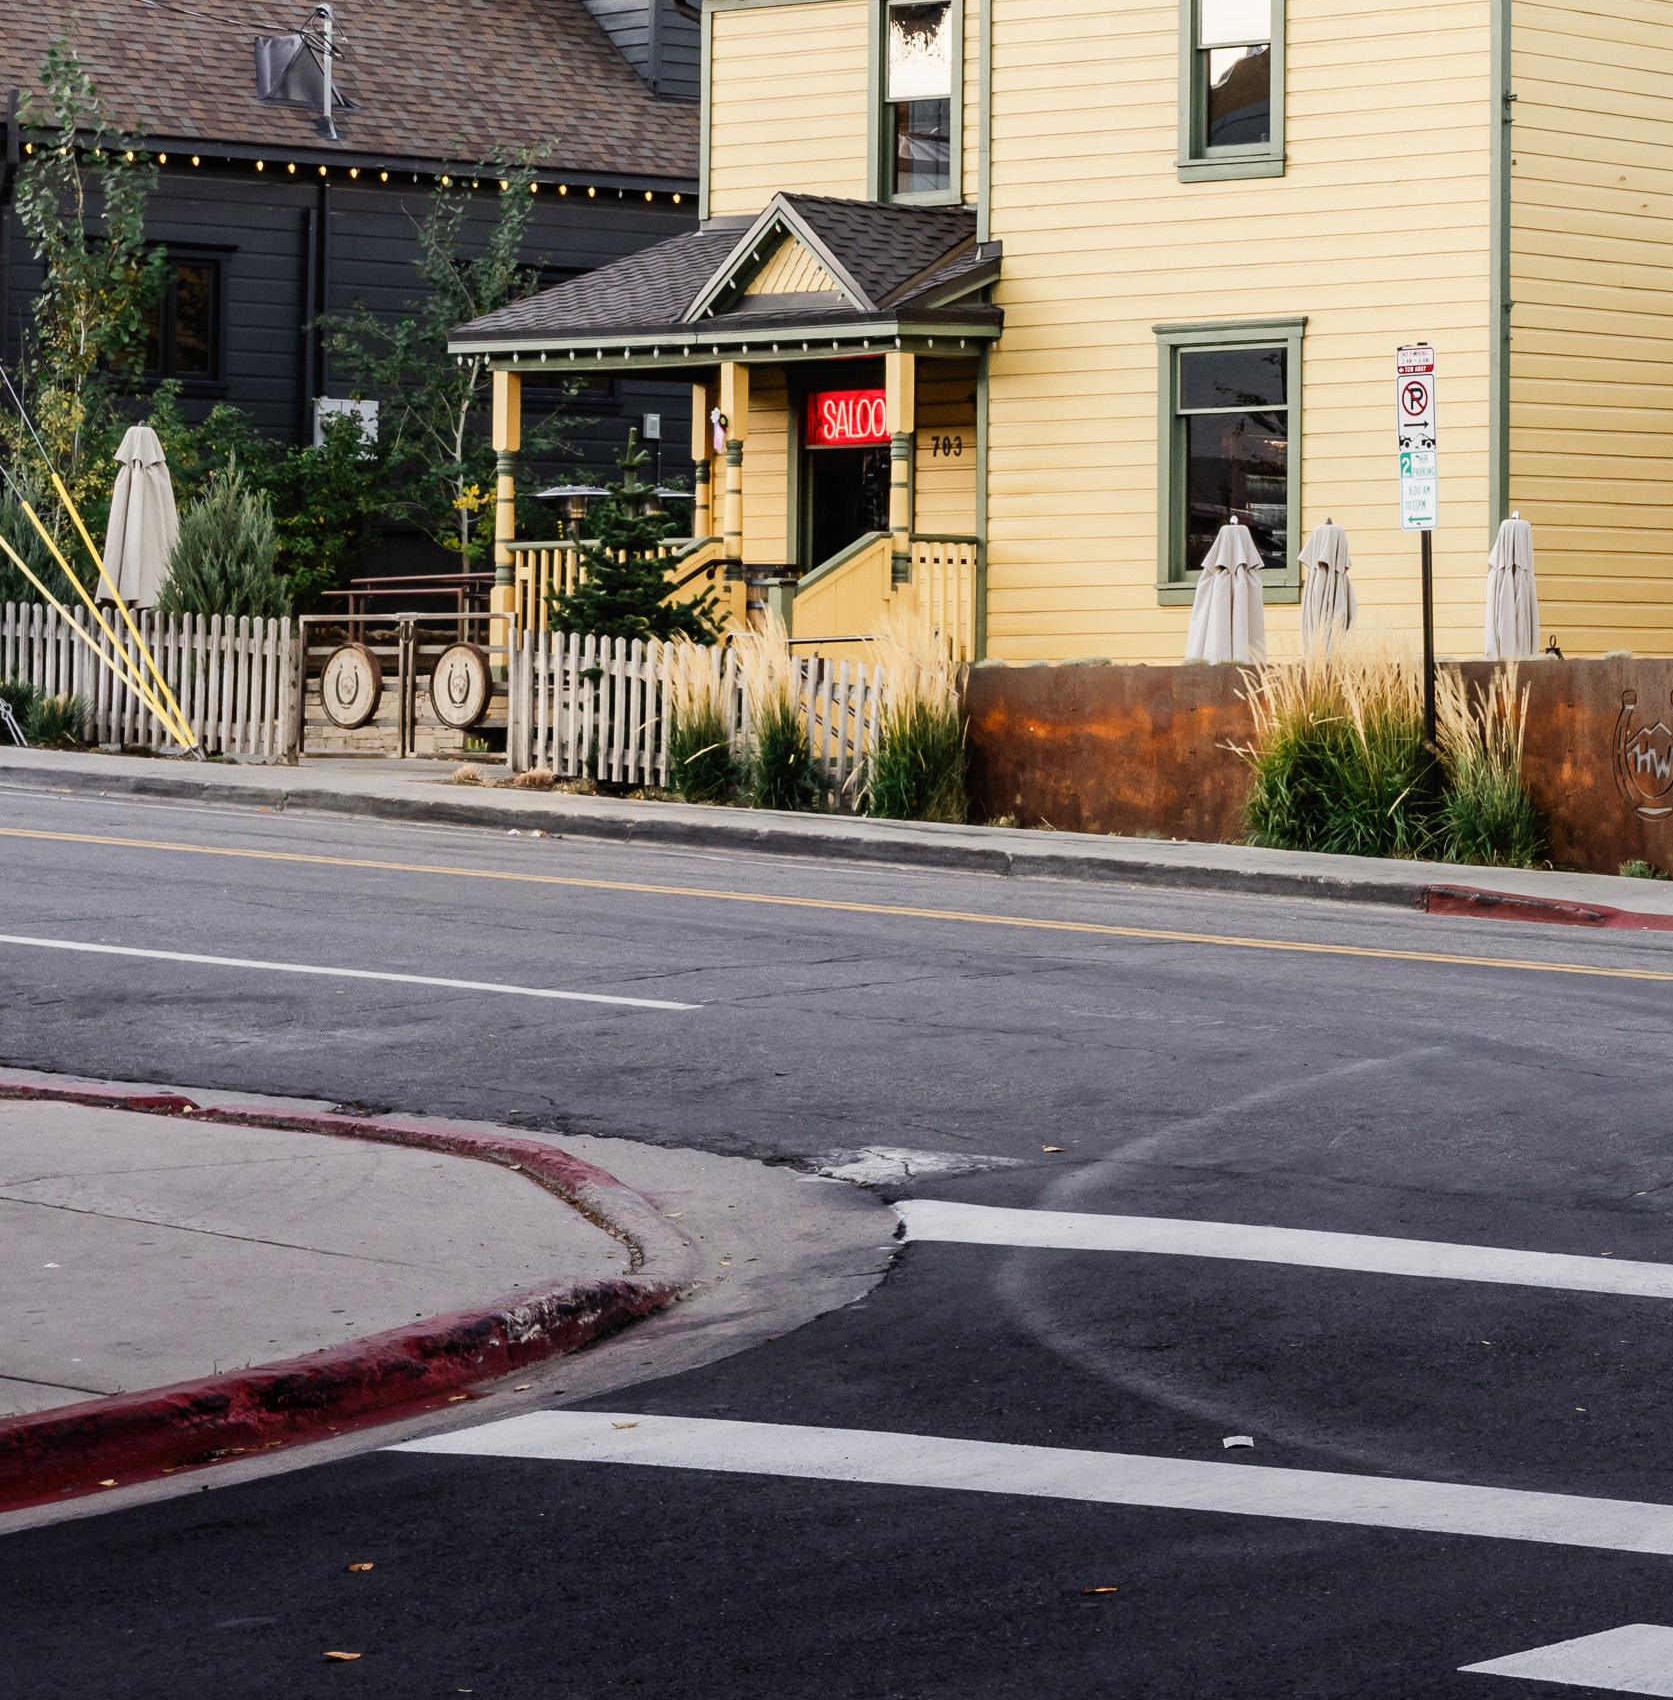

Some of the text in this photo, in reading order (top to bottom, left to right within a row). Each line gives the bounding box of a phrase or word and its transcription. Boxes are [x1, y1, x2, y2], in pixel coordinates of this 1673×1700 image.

[823, 398, 890, 439] SALOO
[931, 436, 962, 457] 703
[1401, 455, 1429, 476] 2 HR
[1412, 467, 1436, 476] PARKING
[1408, 485, 1431, 496] 8:00 AM
